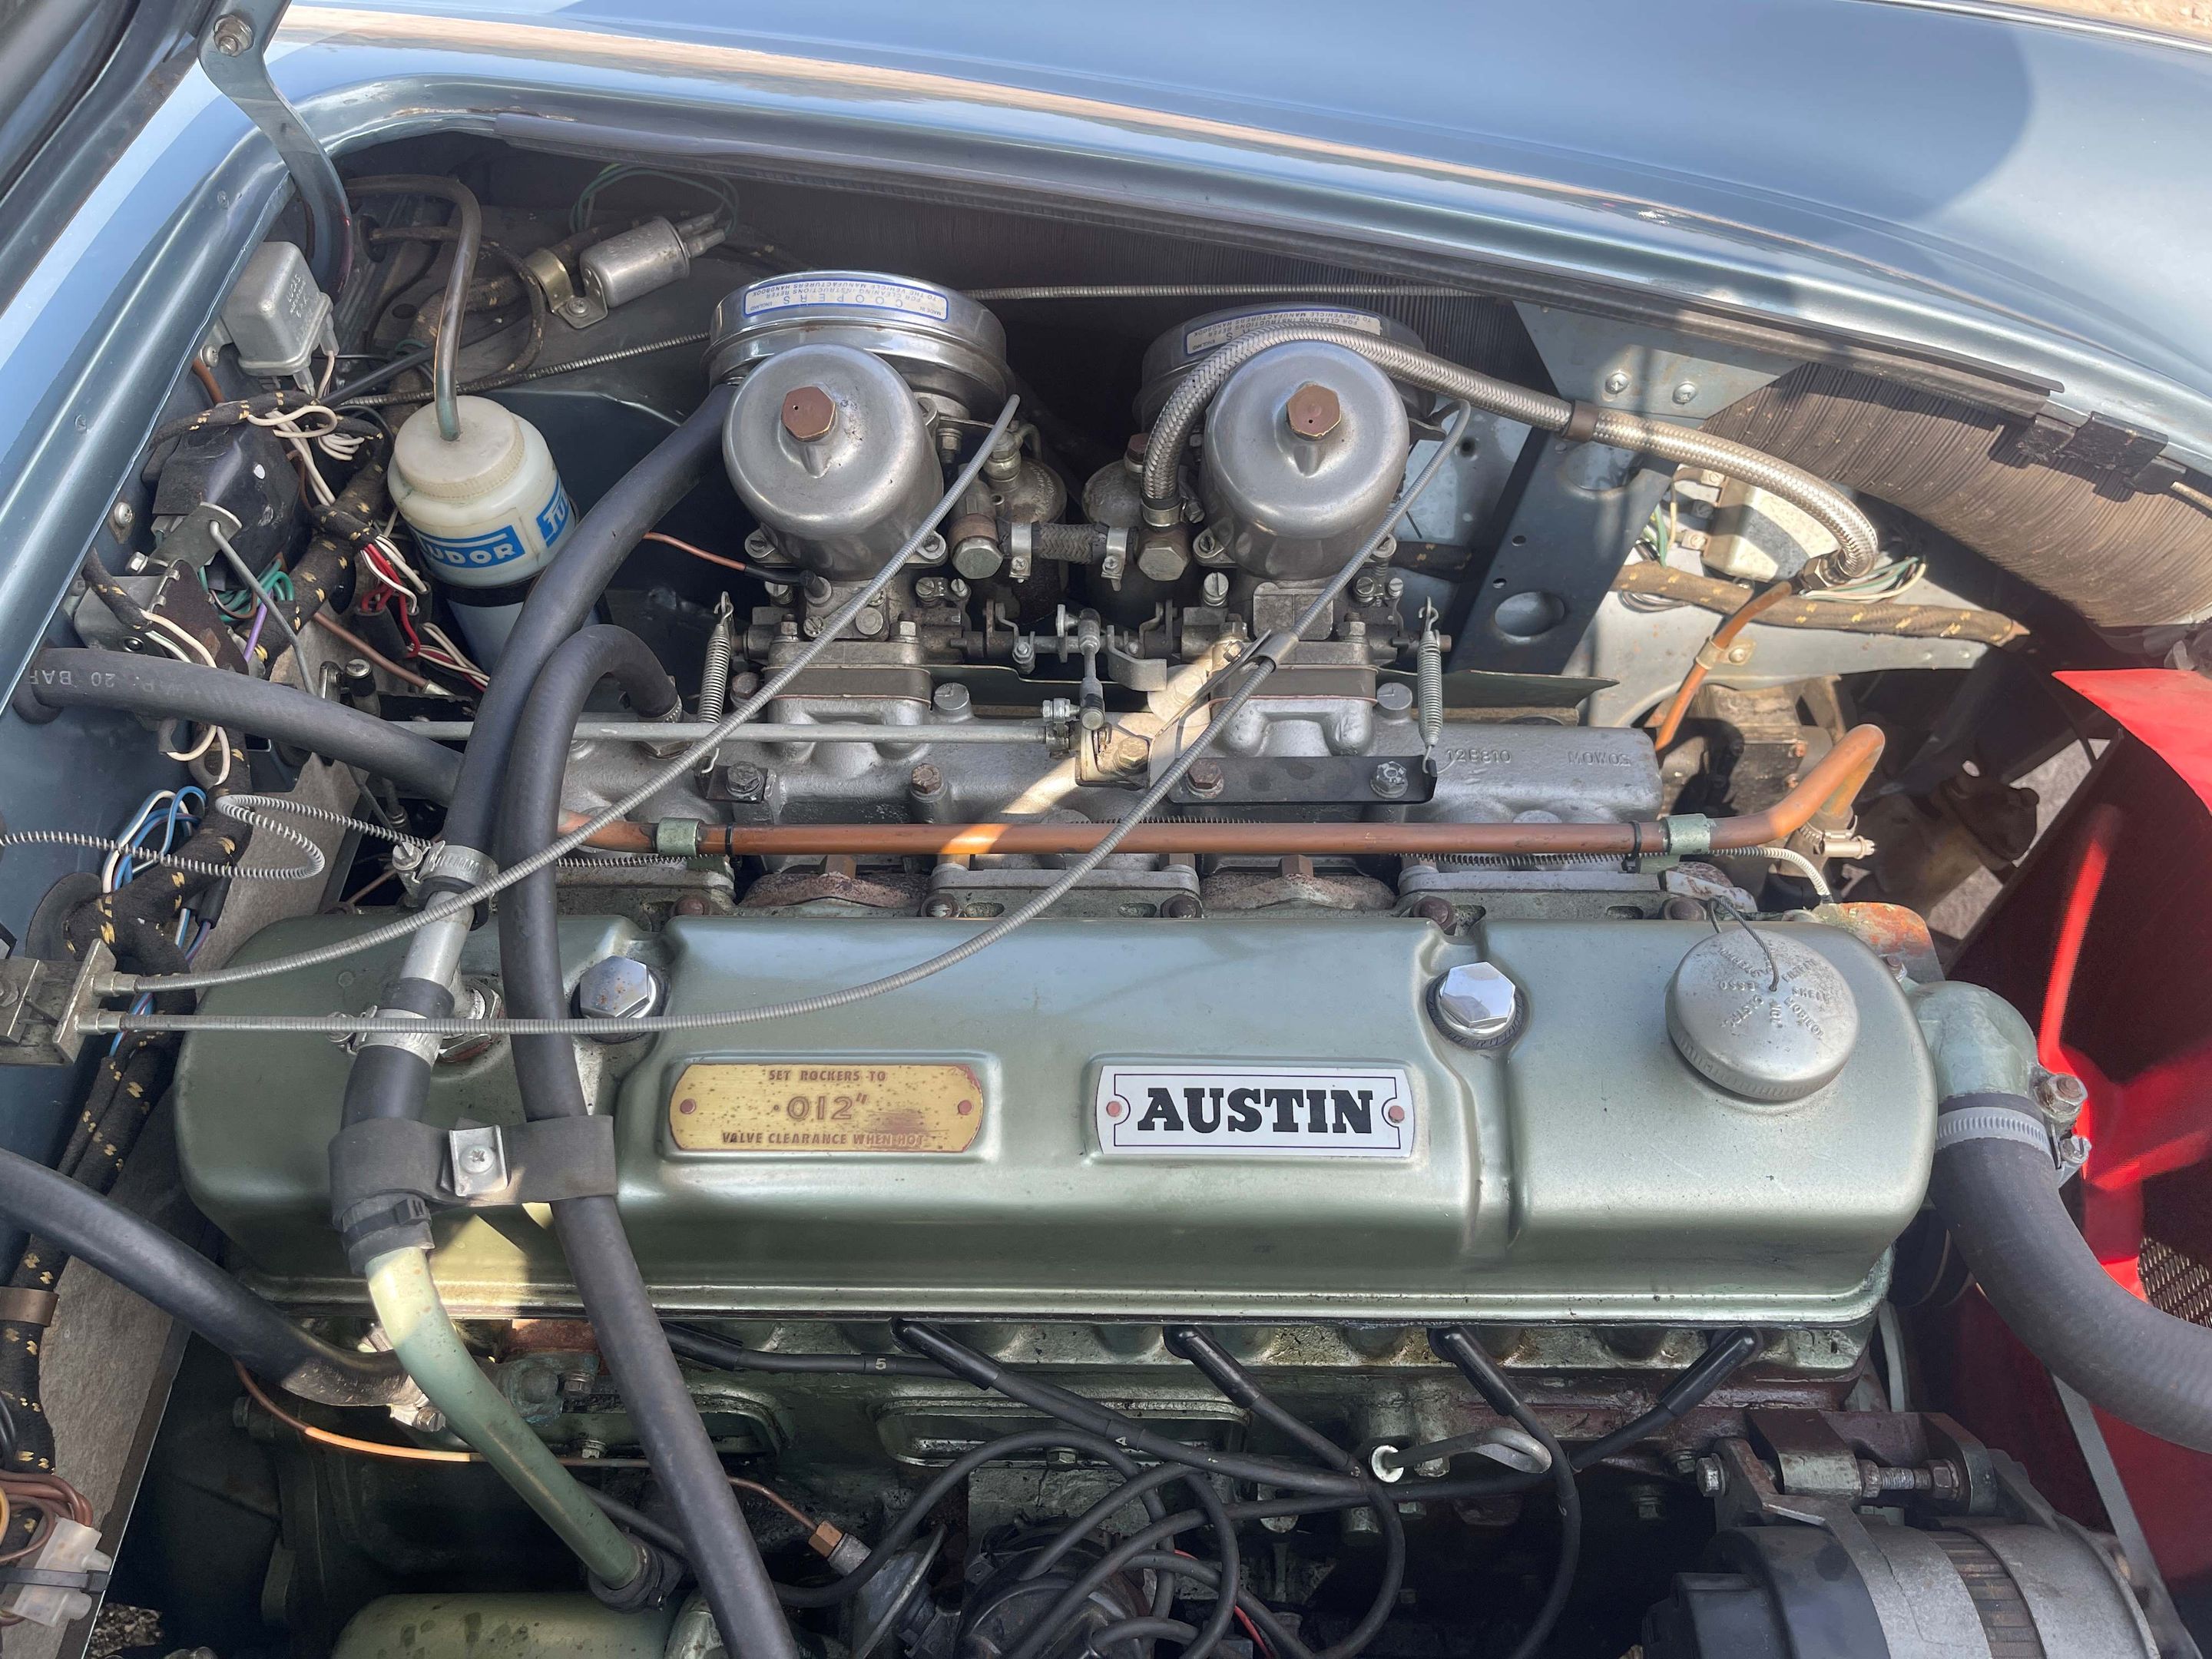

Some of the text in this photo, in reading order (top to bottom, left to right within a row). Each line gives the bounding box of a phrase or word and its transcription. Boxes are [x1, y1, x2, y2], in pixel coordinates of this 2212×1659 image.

[752, 284, 791, 296] HANDBOOK
[766, 286, 922, 303] FOR CLEANING INSTRUCTIONS REFER
[869, 285, 908, 296] VEHICLE
[783, 293, 903, 308] COOPERS
[1235, 316, 1303, 331] INSTRUCTIONS
[1236, 312, 1306, 325] MANUFACTURERS
[1305, 316, 1340, 324] CLEANING
[1192, 320, 1233, 337] HANDBOOK
[1207, 326, 1233, 337] REFER
[91, 671, 116, 687] 20
[1717, 980, 1757, 992] ESSO
[768, 1070, 887, 1081] SET ROCKERS TO
[1137, 1088, 1373, 1134] AUSTIN
[721, 1132, 925, 1146] VALVE CLEARANCE WHEN HOT
[875, 1357, 886, 1371] 5
[1114, 1436, 1128, 1446] 4
